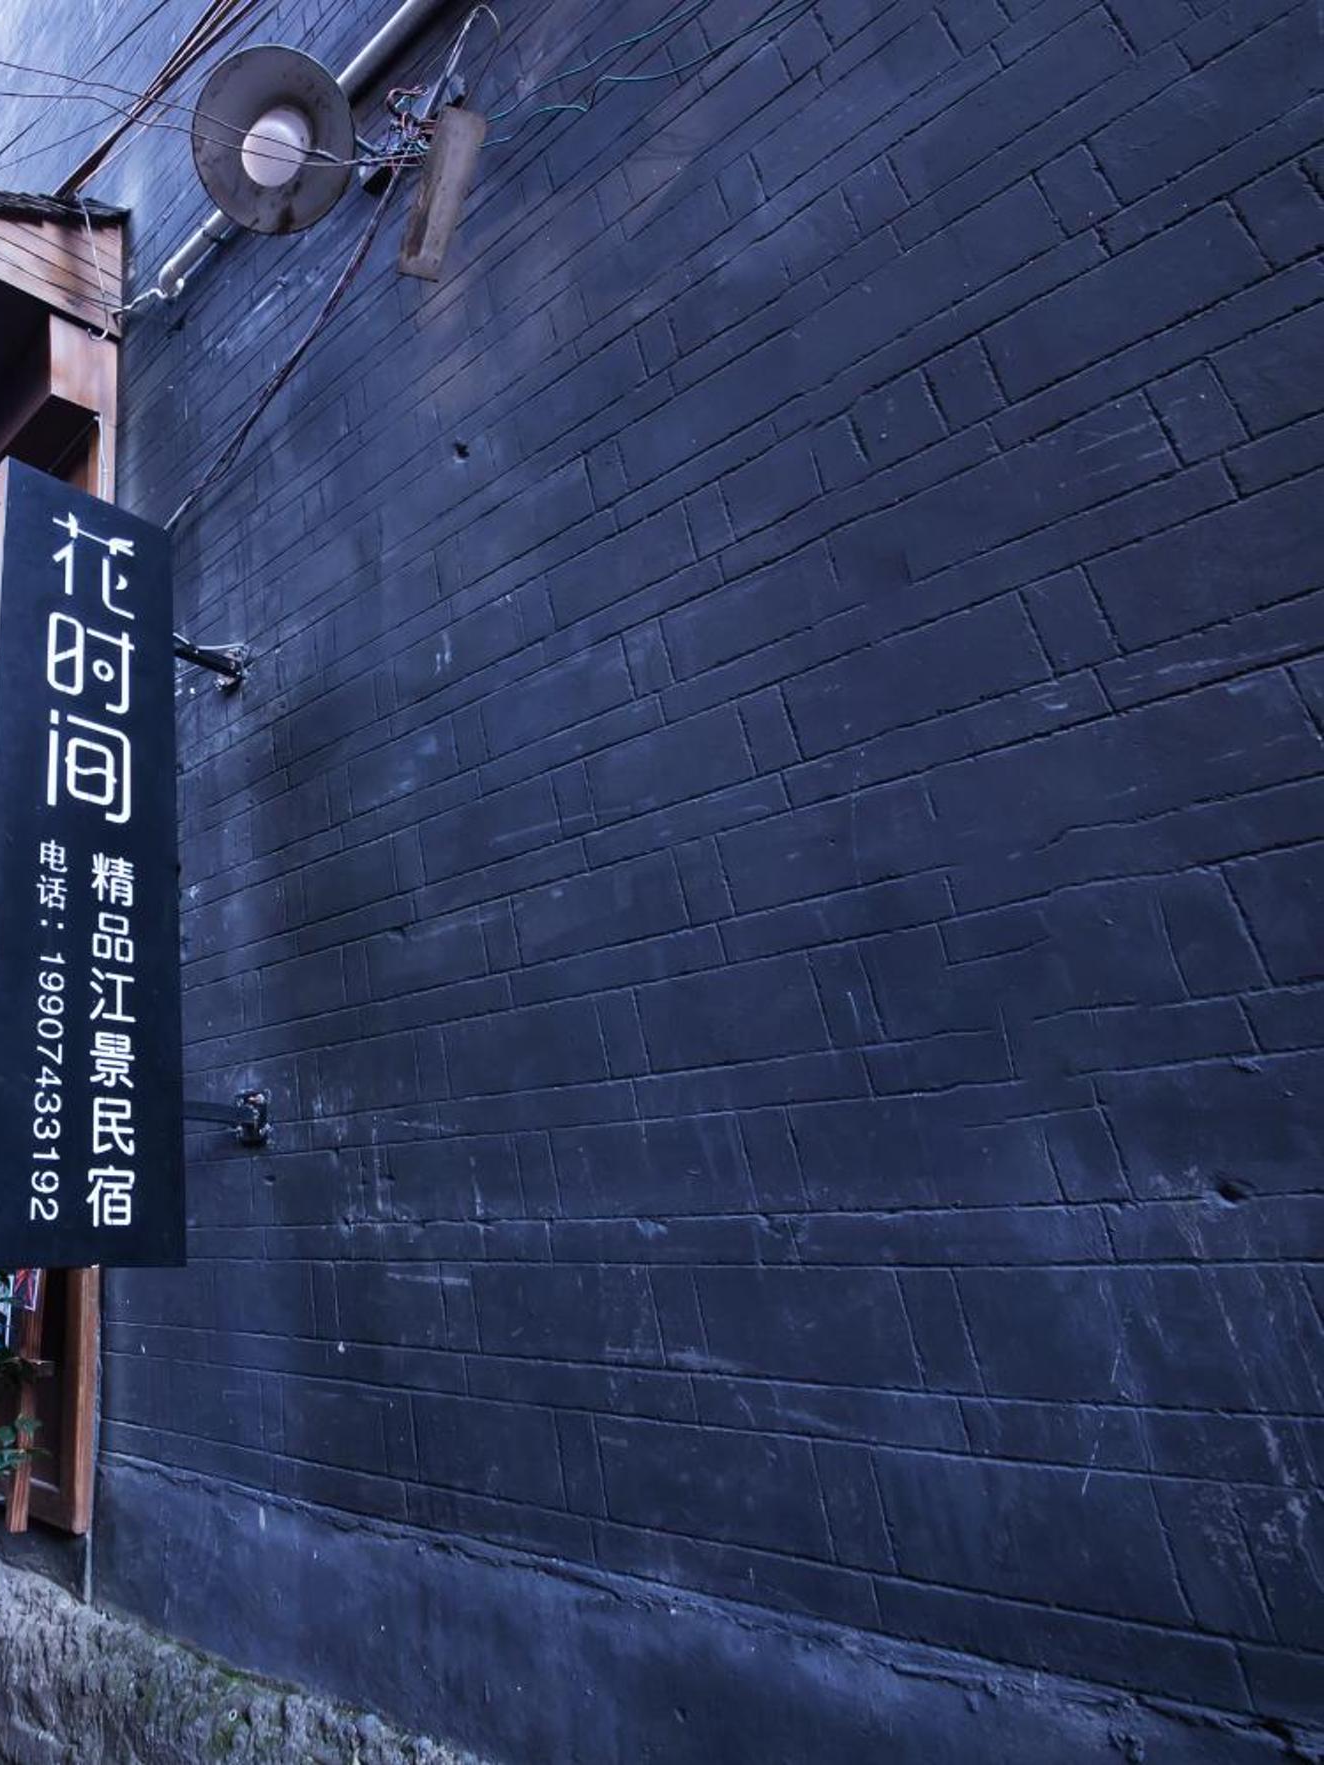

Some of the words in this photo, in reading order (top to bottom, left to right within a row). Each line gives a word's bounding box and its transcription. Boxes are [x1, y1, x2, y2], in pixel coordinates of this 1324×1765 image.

[43, 512, 135, 824] 花时间
[86, 852, 136, 1228] 精品江景民宿
